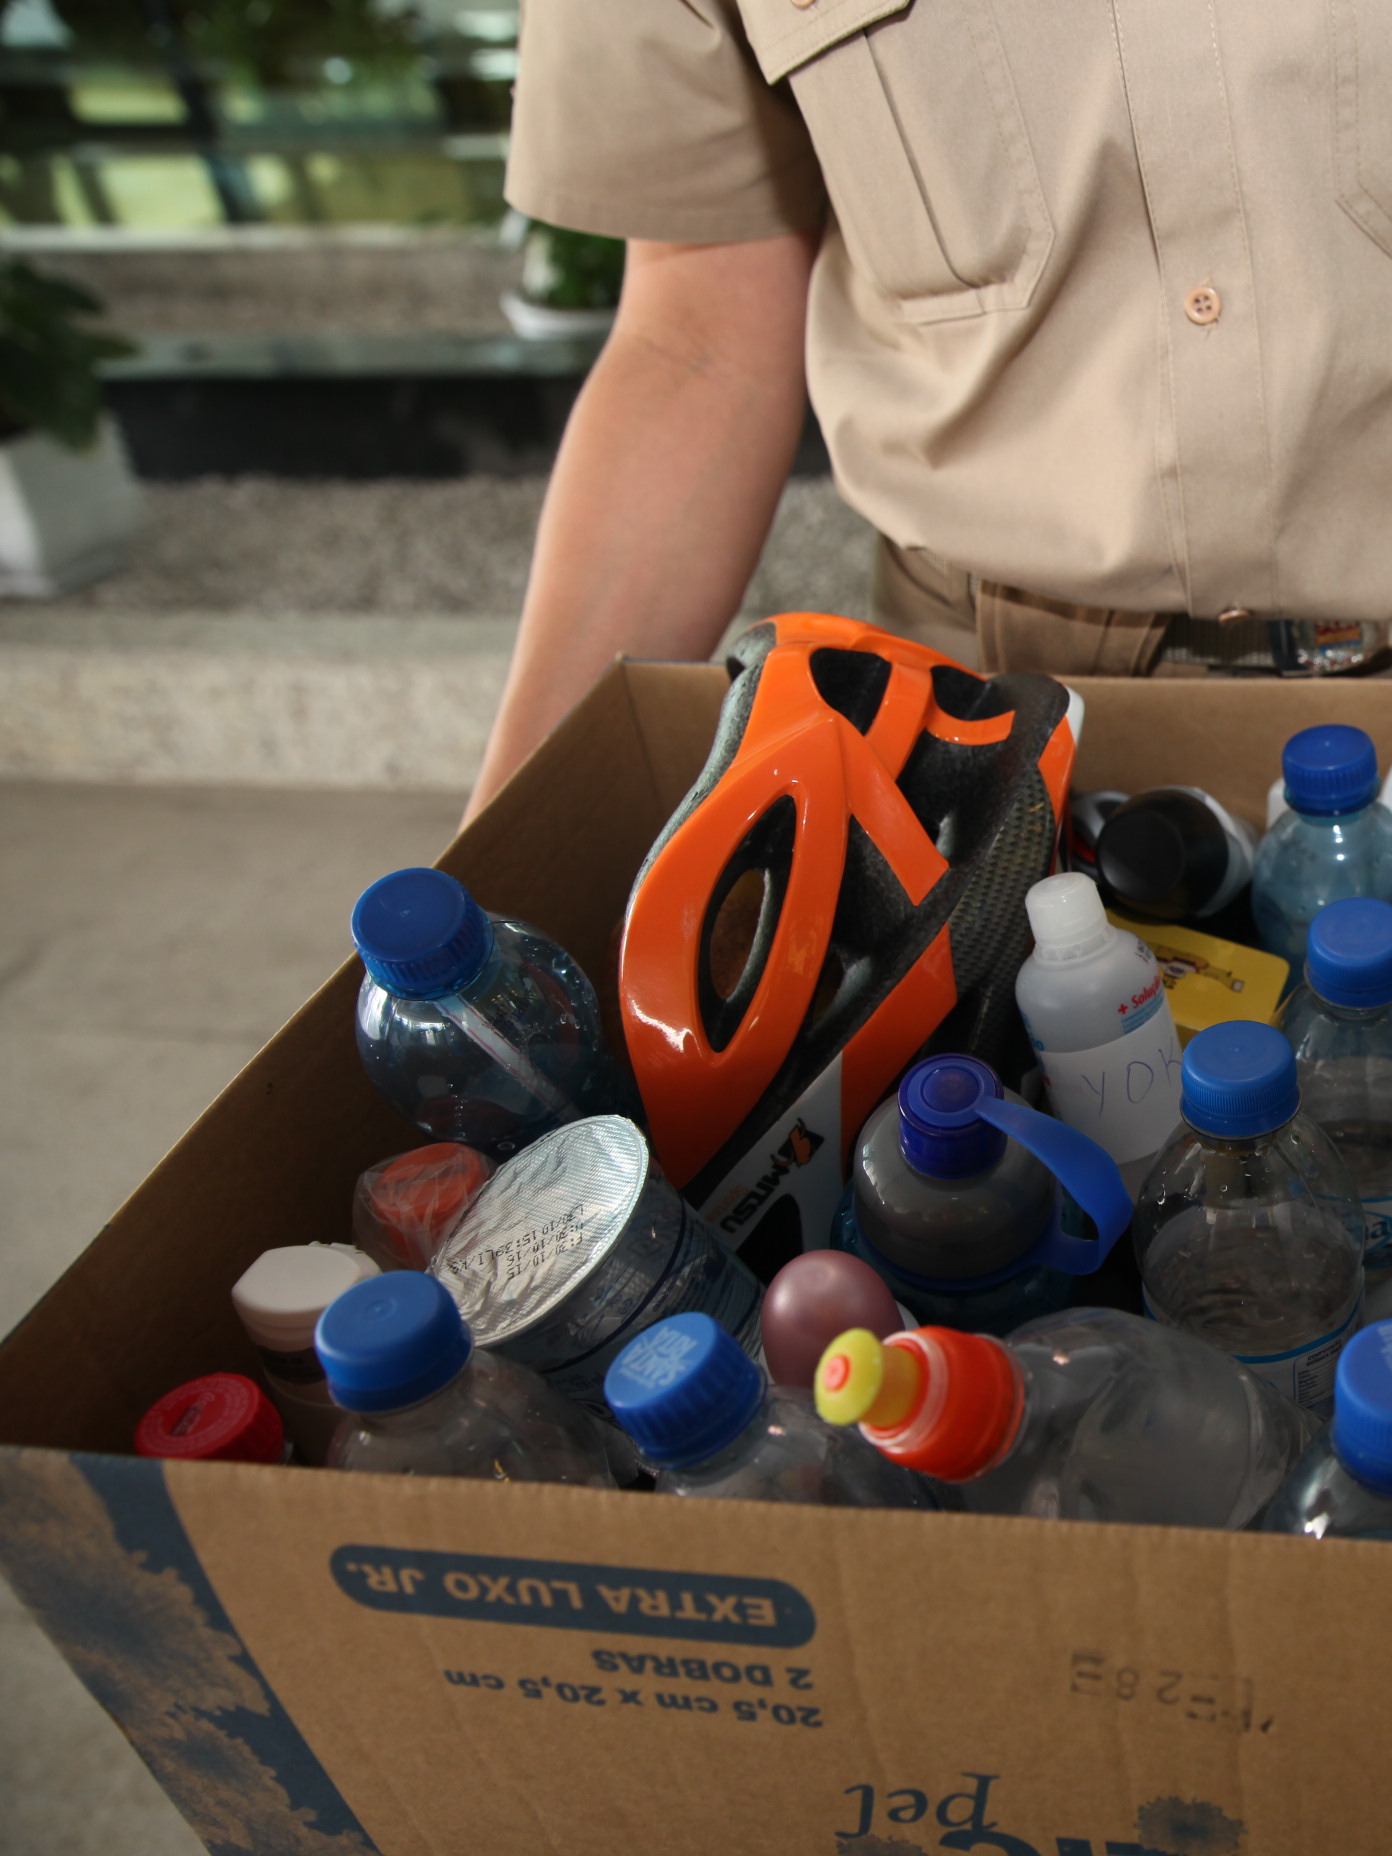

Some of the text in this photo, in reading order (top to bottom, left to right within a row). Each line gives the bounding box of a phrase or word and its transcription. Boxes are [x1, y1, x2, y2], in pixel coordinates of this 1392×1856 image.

[346, 1561, 776, 1628] EXTRA LUXO JR.
[443, 1668, 824, 1730] 20,5 cm x 20,5 cm
[592, 1648, 815, 1691] 2 DOBRAS
[835, 1772, 1001, 1839] pel
